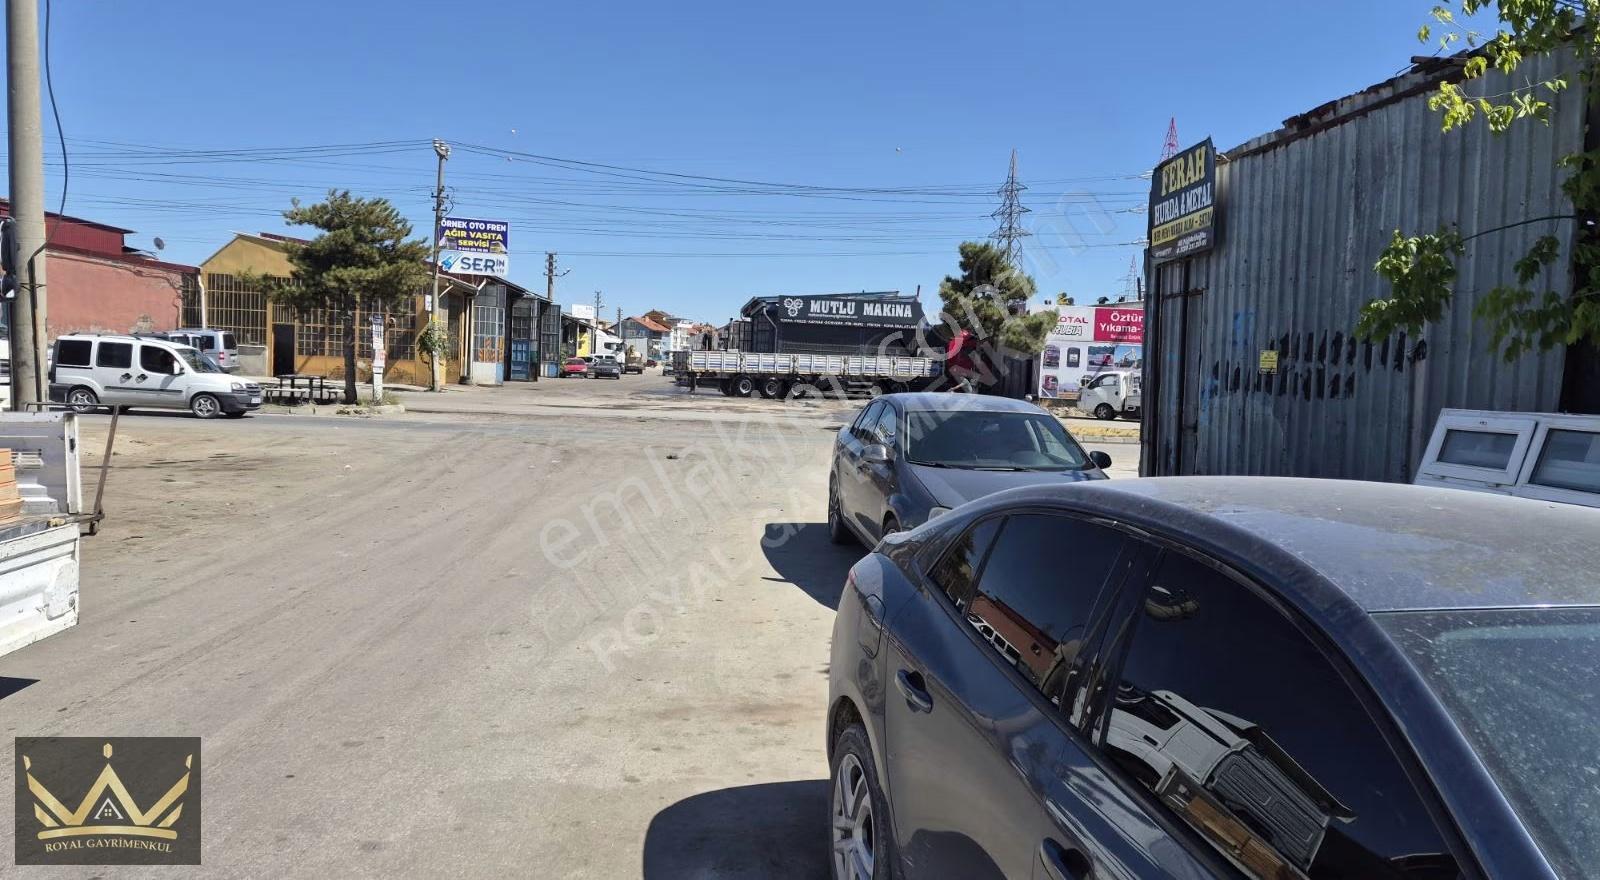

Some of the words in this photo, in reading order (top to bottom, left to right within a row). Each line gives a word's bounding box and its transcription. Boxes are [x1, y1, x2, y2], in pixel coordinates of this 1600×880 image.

[1161, 146, 1206, 197] FERAH
[1154, 197, 1179, 226] HURDA
[1186, 182, 1212, 213] METAL
[441, 218, 467, 229] ÖRNEK
[469, 222, 485, 230] OTO
[487, 223, 506, 232] FREN
[444, 228, 467, 238] AĞIR
[469, 231, 503, 240] VASITA
[458, 239, 489, 248] SERVİSİ
[810, 299, 856, 315] MUTLU
[1100, 322, 1143, 333] Yıkama-
